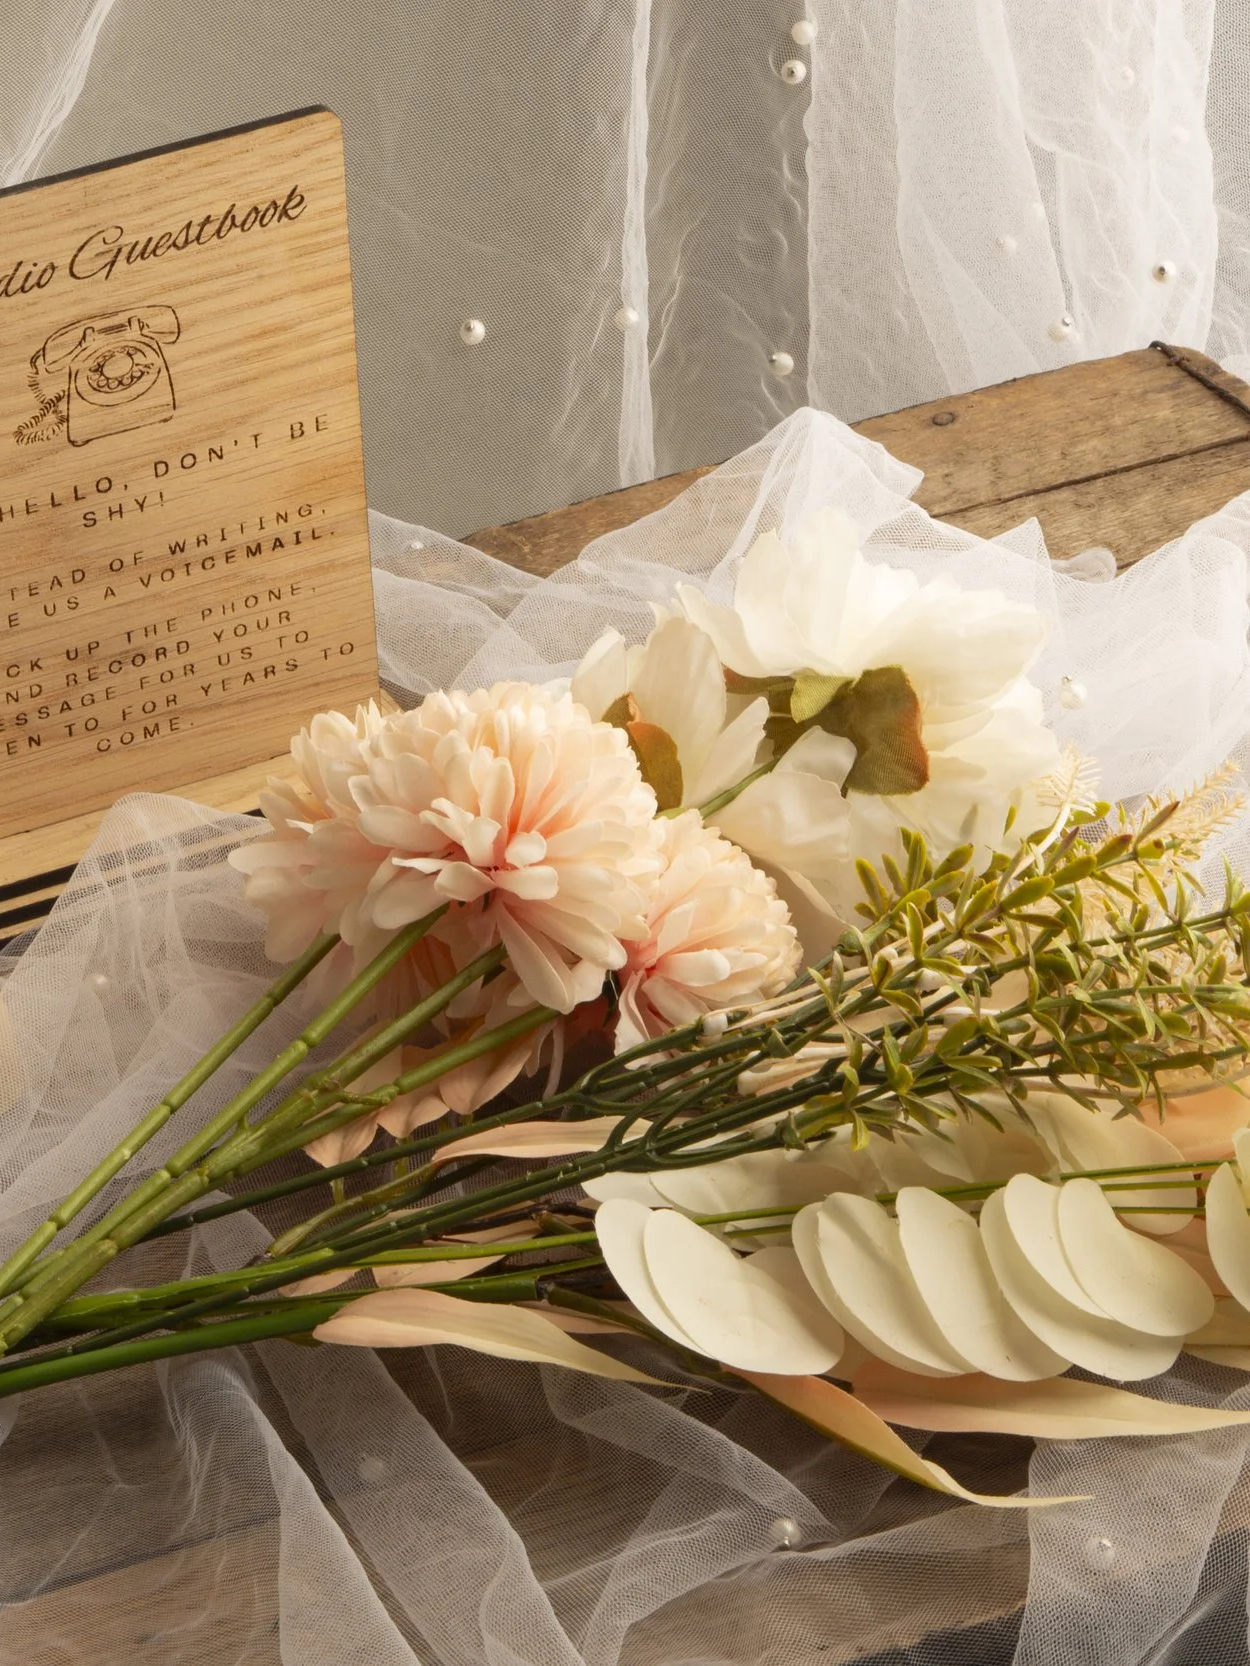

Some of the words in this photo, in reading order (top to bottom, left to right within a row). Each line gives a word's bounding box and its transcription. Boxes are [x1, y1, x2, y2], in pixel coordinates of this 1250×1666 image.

[69, 184, 308, 281] Guestbook
[154, 433, 262, 479] DON'T
[290, 414, 330, 440] BE
[83, 492, 166, 528] SHY!
[110, 551, 145, 572] OF
[169, 503, 327, 555] WRITING,
[44, 596, 80, 618] US
[103, 586, 117, 601] A
[140, 528, 336, 589] VOICEMAIL.
[66, 640, 102, 662] UP
[124, 618, 178, 645] THE
[67, 640, 191, 687] RECORD
[213, 610, 292, 643] YOUR
[140, 664, 197, 690] FOR
[218, 646, 253, 666] US
[278, 629, 310, 650] TO
[64, 718, 100, 738] TO
[122, 694, 179, 722] FOR
[201, 659, 299, 697] YEARS
[322, 641, 355, 662] TO
[96, 717, 195, 753] COME.
